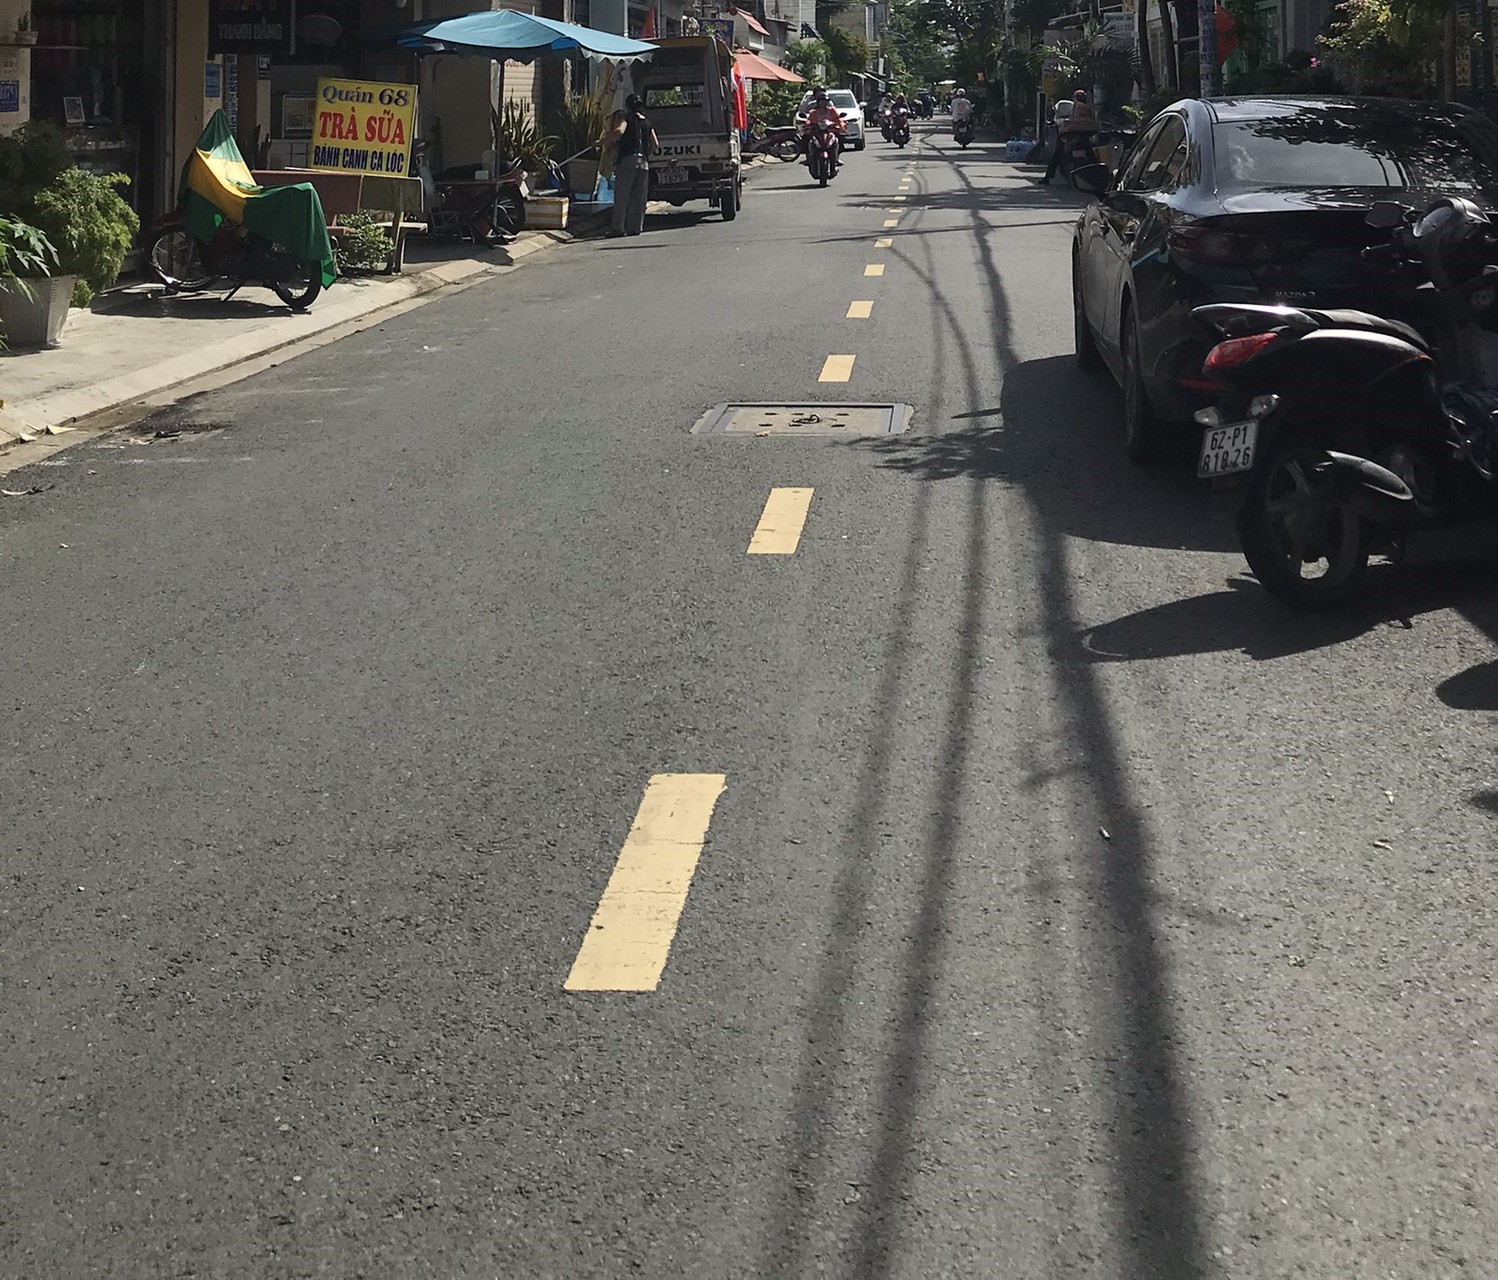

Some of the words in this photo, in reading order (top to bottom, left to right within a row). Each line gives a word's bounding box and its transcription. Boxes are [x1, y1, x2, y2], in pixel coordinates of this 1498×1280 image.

[322, 85, 373, 104] Quán
[379, 87, 409, 107] 68
[319, 106, 359, 141] TRÀ
[365, 108, 406, 145] SỮA
[313, 143, 340, 168] BÁNH
[342, 147, 369, 170] CANH
[371, 148, 384, 172] CÁ
[386, 149, 405, 173] LÓC
[652, 144, 701, 156] UZUKI
[1210, 425, 1248, 451] 62-P1
